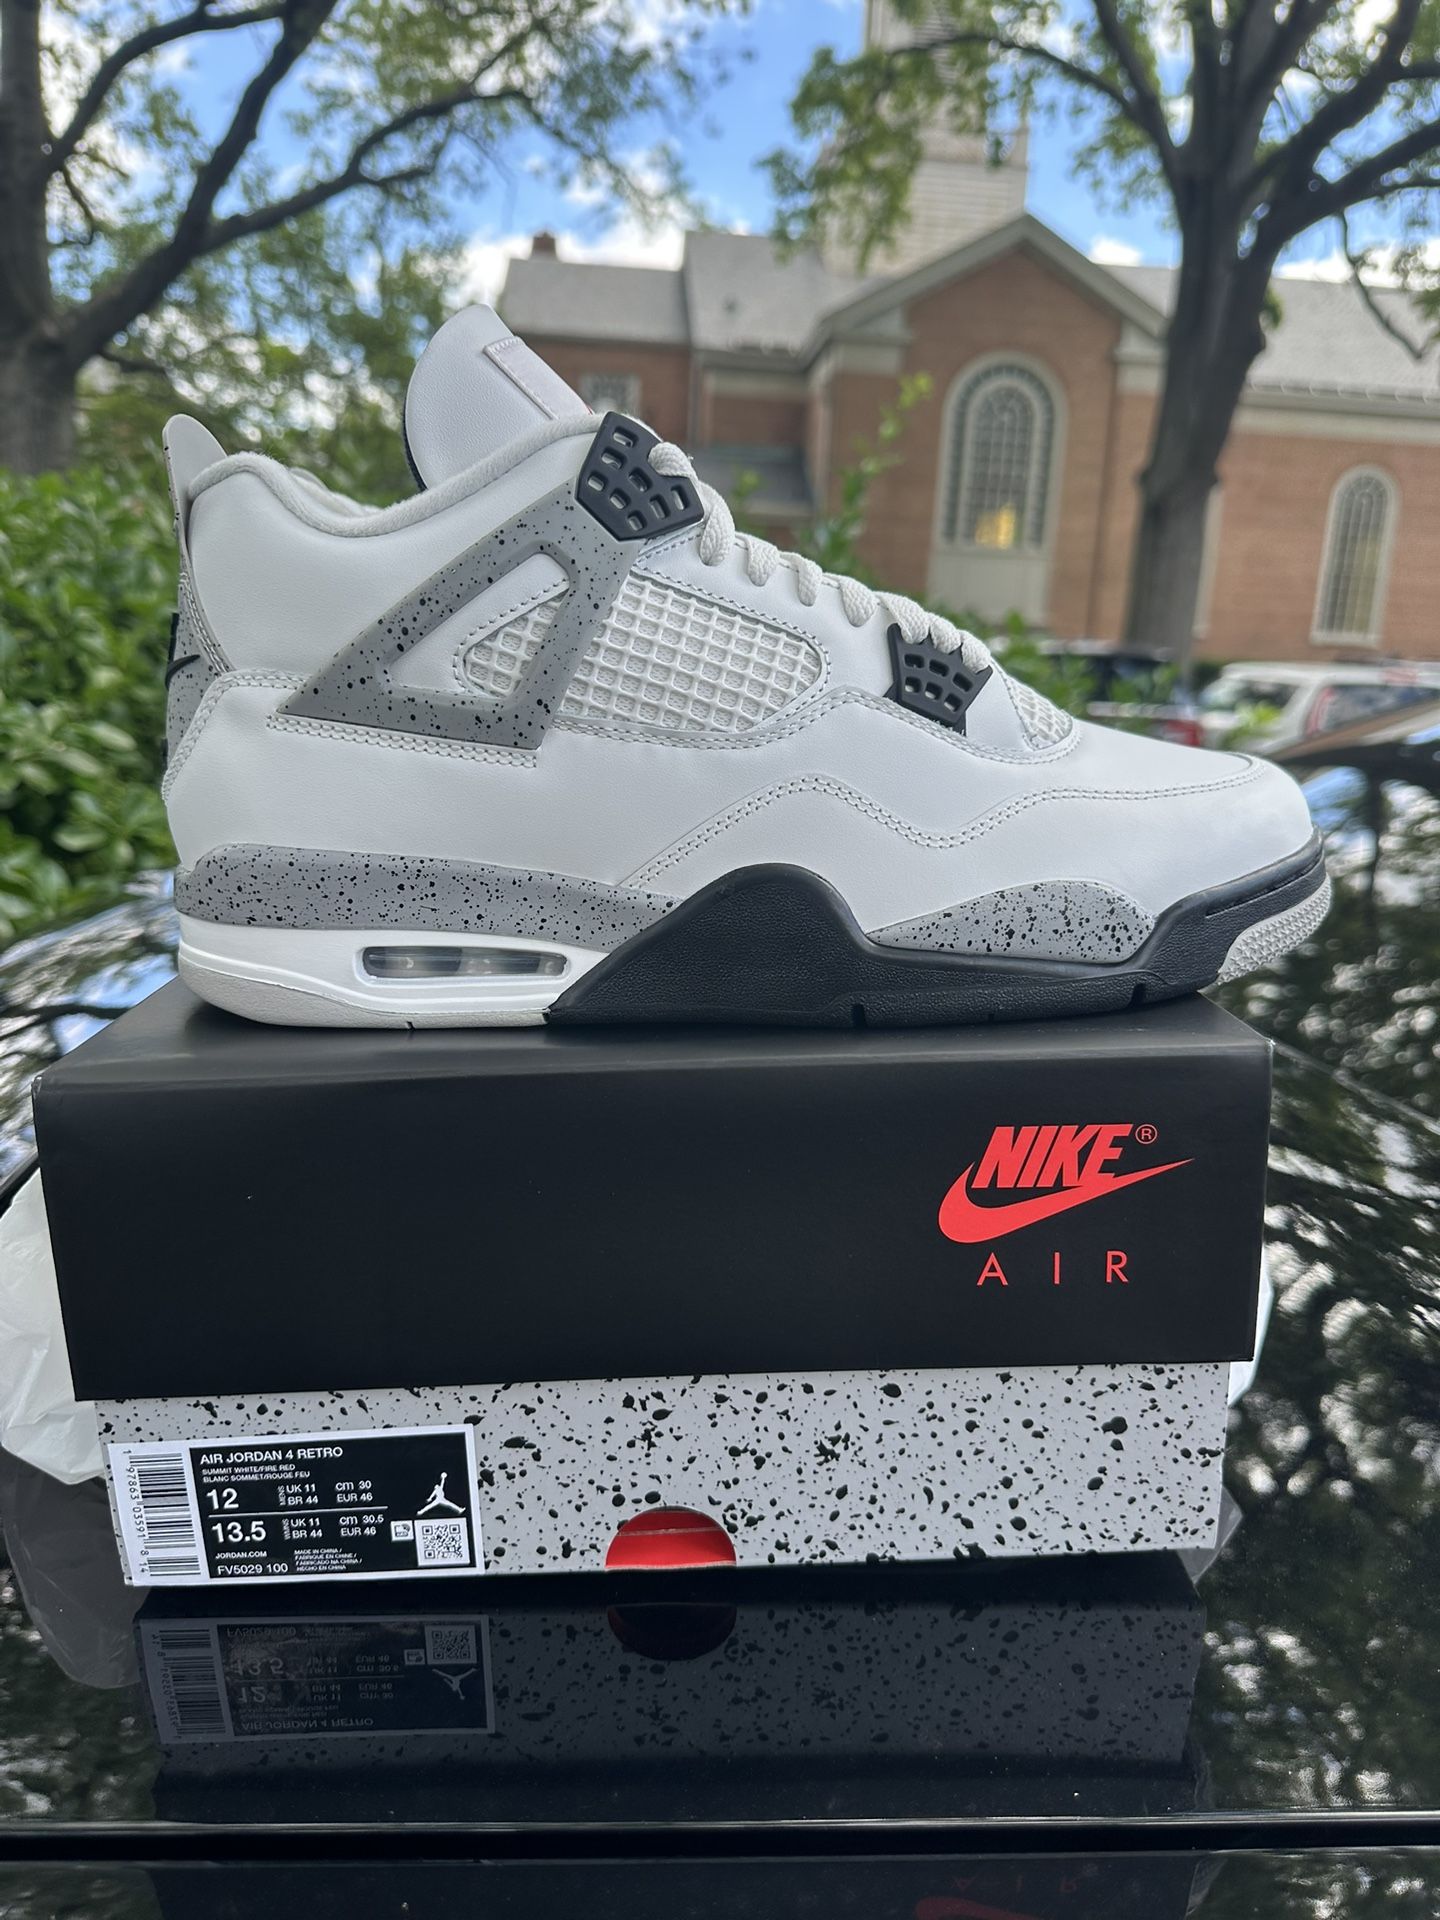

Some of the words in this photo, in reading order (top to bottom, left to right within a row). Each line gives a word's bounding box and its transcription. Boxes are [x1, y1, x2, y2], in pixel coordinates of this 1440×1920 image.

[971, 1123, 1134, 1188] NIKE
[976, 1250, 1128, 1286] AIR
[200, 1453, 223, 1465] AIR
[226, 1450, 282, 1463] JORDAN
[285, 1450, 294, 1459] 4
[297, 1447, 343, 1459] RETRO
[202, 1467, 233, 1475] SUMMIT
[203, 1475, 229, 1483] BLANC
[286, 1484, 302, 1494] UK
[304, 1483, 316, 1493] 11
[335, 1482, 354, 1491] cm
[359, 1480, 372, 1490] 30
[206, 1488, 239, 1510] 12
[287, 1495, 304, 1506] BR
[305, 1495, 319, 1505] 44
[337, 1493, 357, 1503] EUR
[360, 1492, 373, 1502] 46
[132, 1506, 146, 1538] 03591
[291, 1518, 307, 1528] UK
[308, 1517, 321, 1527] 11
[339, 1516, 358, 1525] cm
[362, 1514, 384, 1524] 30.5
[211, 1520, 267, 1543] 13.5
[292, 1529, 308, 1539] BR
[310, 1528, 323, 1538] 44
[341, 1527, 361, 1537] EUR
[363, 1526, 376, 1536] 46
[215, 1550, 267, 1559] JORDAN.COM
[217, 1563, 263, 1575] FV5029
[266, 1562, 289, 1573] 100
